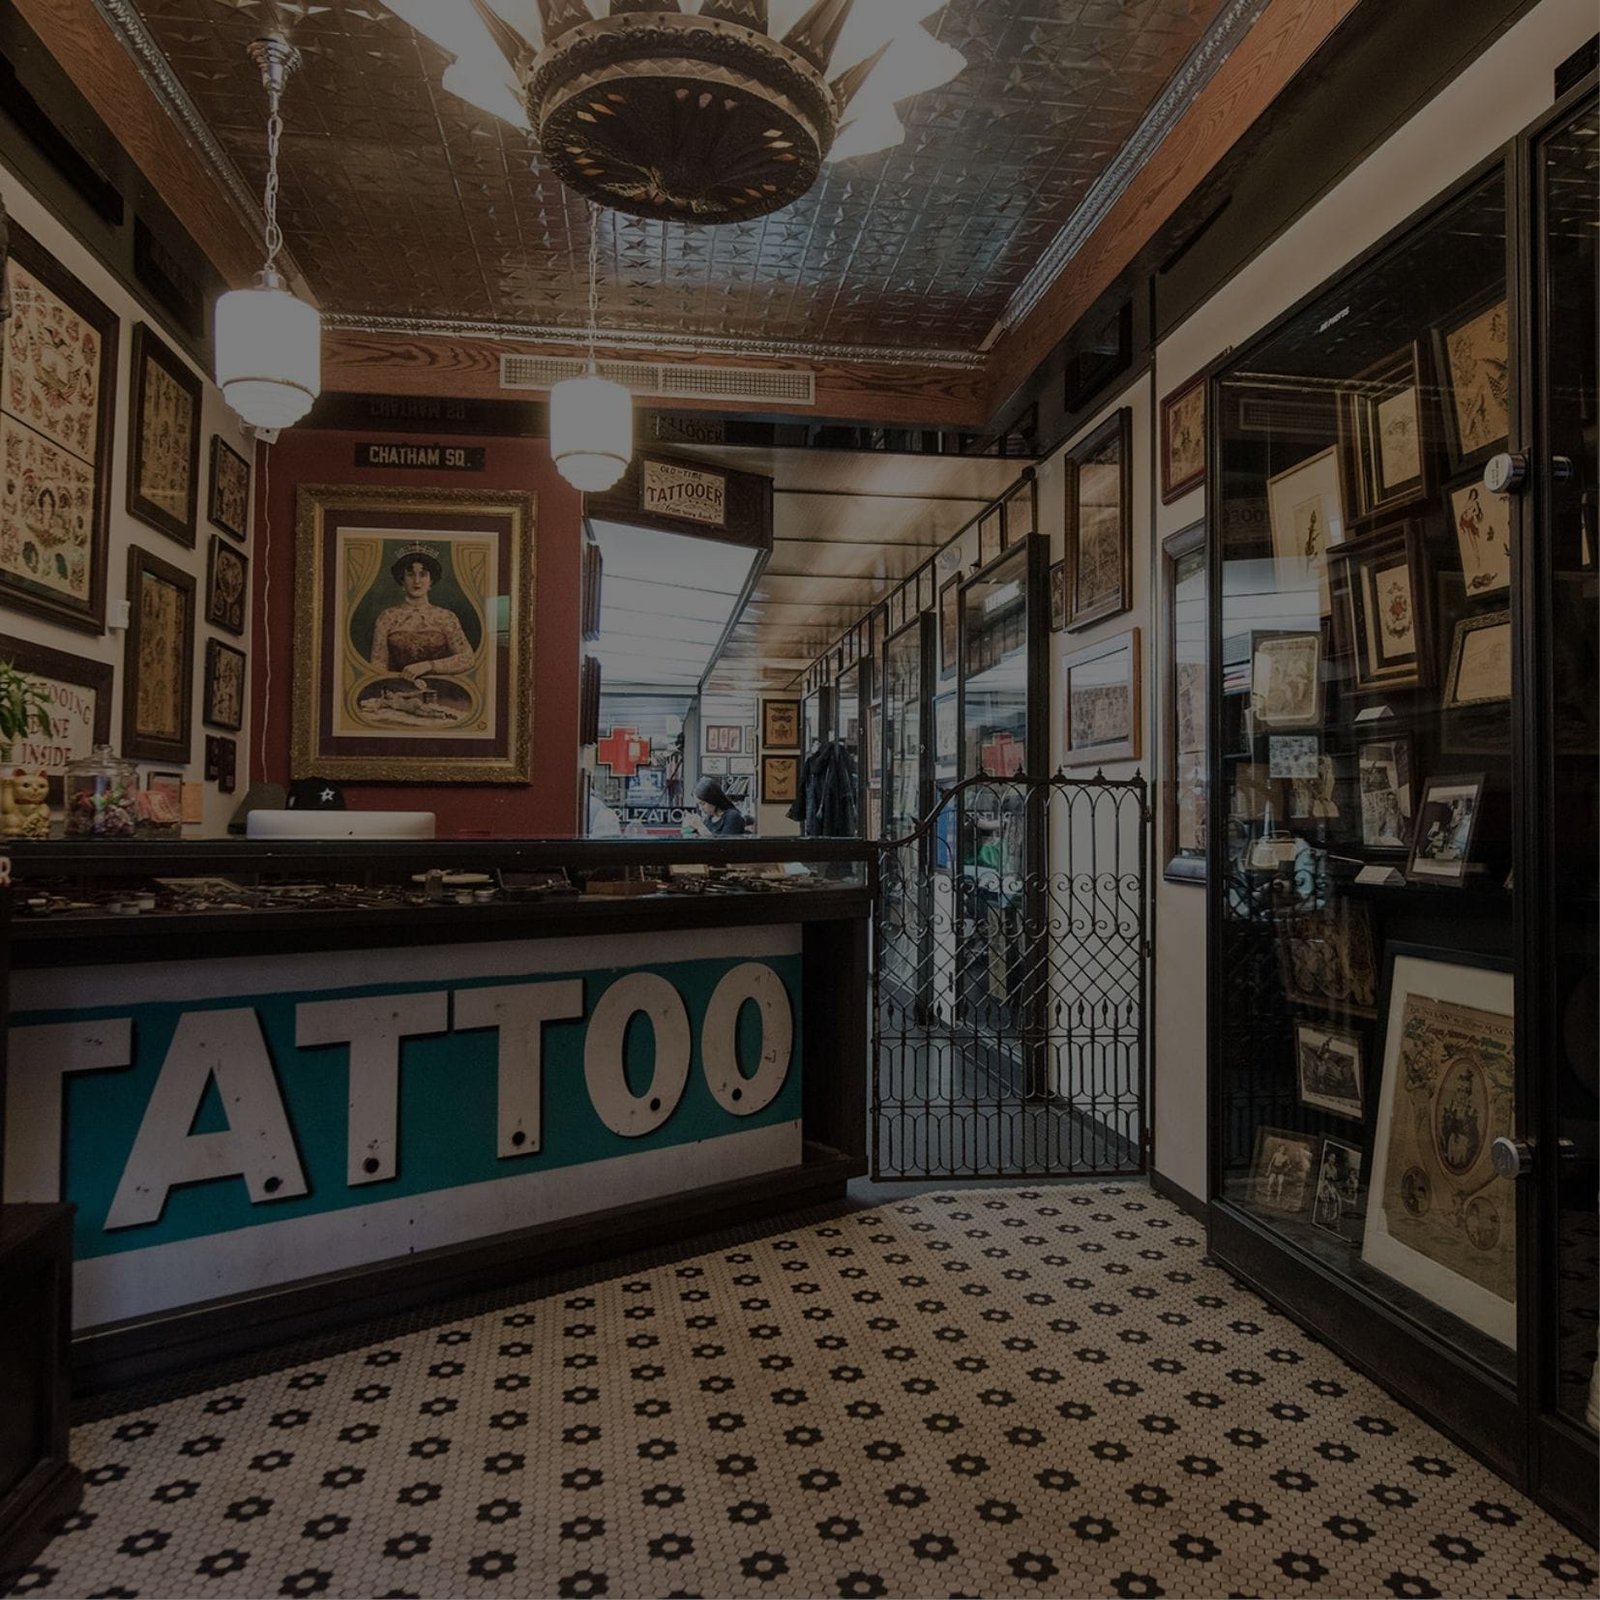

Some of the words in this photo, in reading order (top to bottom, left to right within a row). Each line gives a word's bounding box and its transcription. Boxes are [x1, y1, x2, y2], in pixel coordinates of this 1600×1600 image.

[369, 445, 441, 466] CHATHAM
[647, 482, 722, 506] TATTOOER
[22, 743, 72, 767] INSIDE
[613, 807, 697, 823] RILIZATION
[6, 961, 795, 1232] TATTOO
